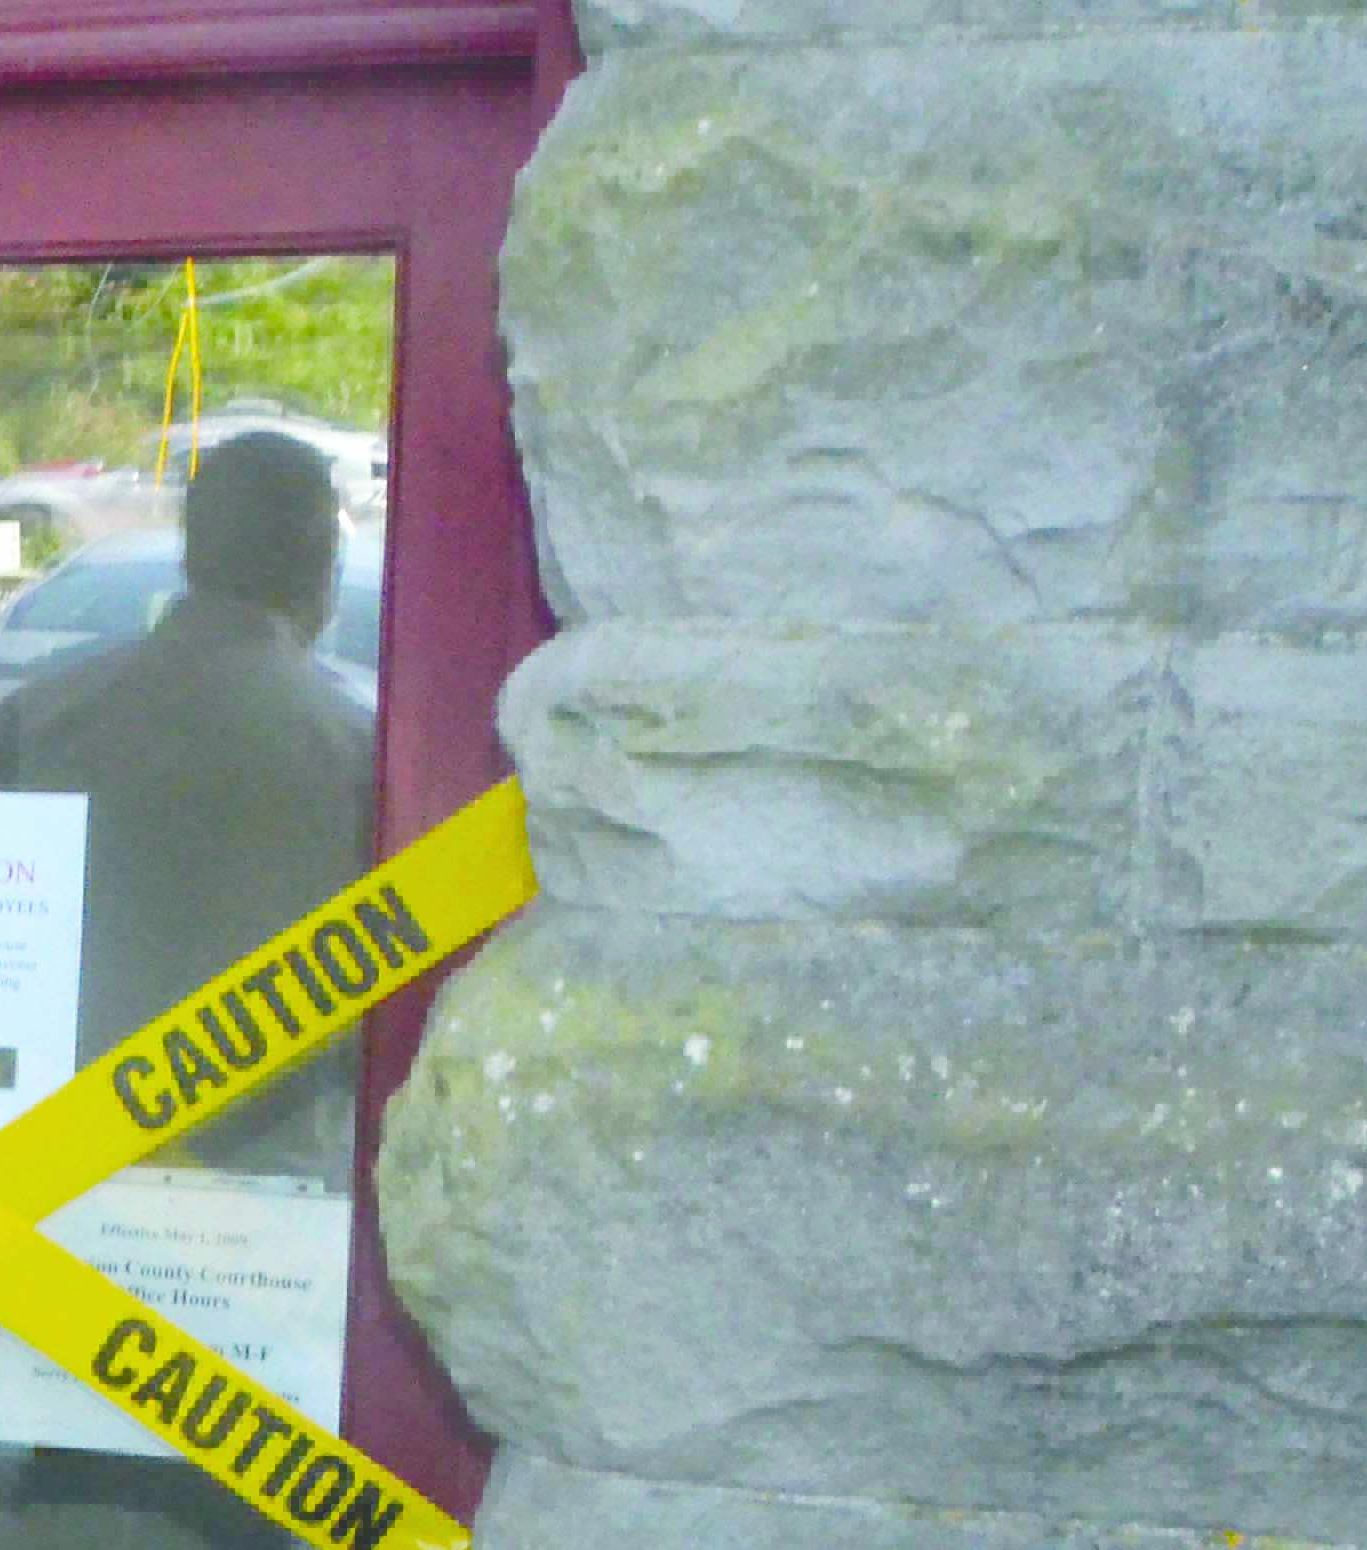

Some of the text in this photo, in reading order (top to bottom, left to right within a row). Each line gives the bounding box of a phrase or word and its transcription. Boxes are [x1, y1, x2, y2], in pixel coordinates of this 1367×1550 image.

[113, 880, 430, 1131] CAUTION
[124, 1259, 193, 1284] County
[199, 1264, 312, 1292] Courthouse
[171, 1288, 230, 1309] Hours
